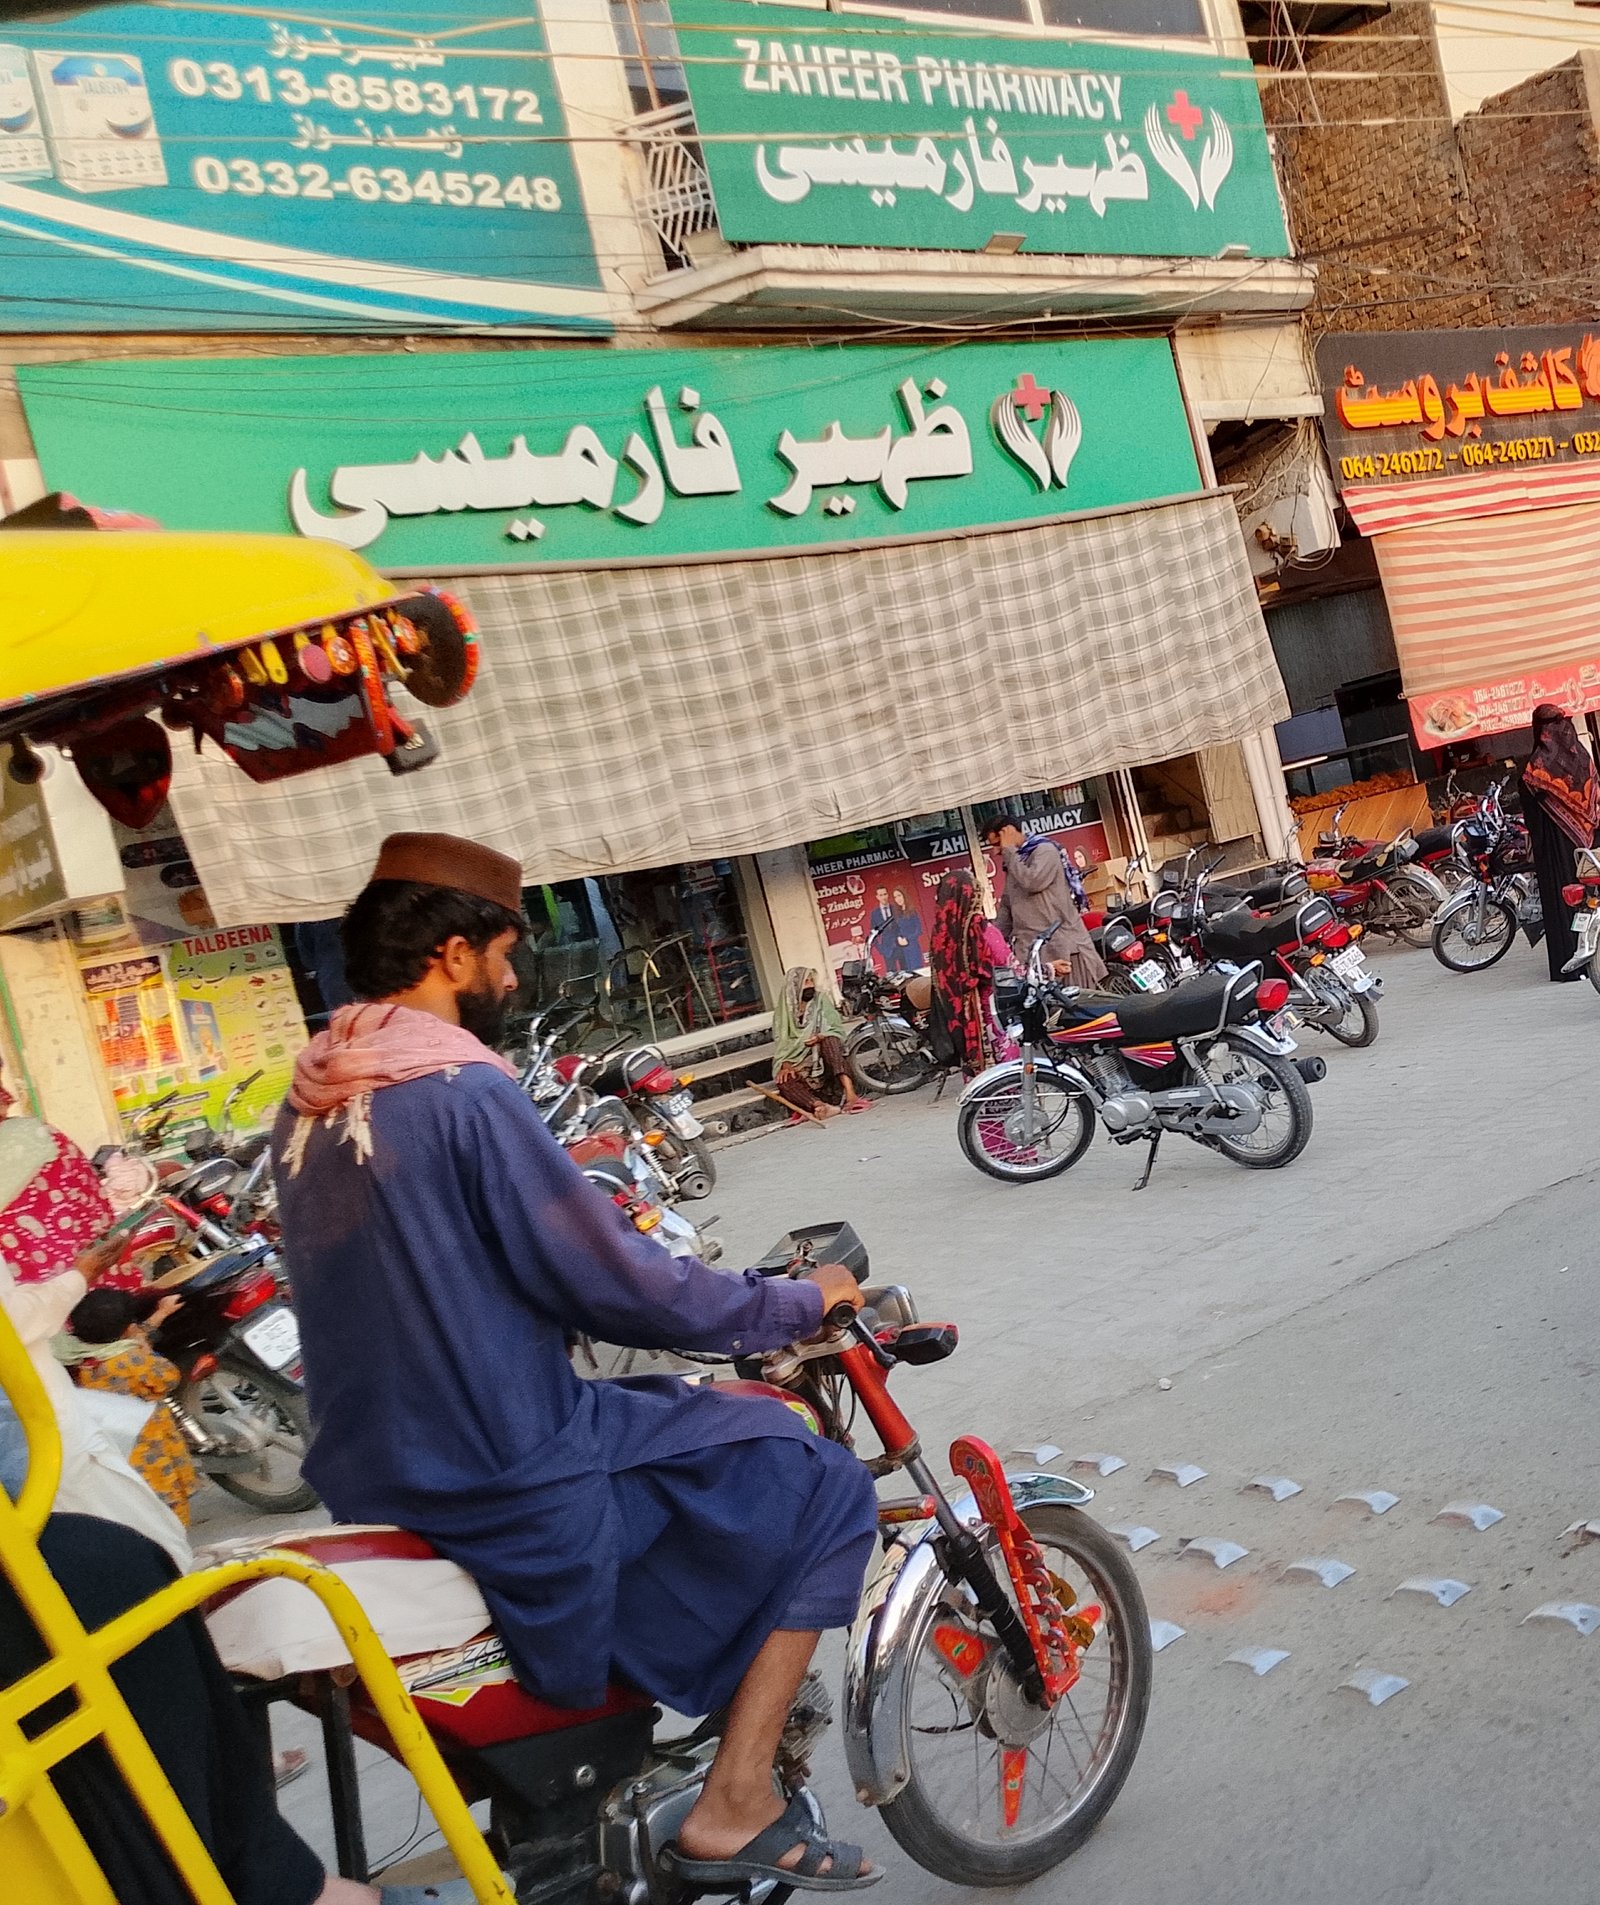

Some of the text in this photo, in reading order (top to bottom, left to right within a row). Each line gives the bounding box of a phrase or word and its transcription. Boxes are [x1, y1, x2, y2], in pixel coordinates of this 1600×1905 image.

[167, 58, 544, 126] 0313-8583172
[735, 37, 1123, 122] ZAHEER PHARMACY
[193, 156, 563, 212] 0332-6345248
[755, 115, 1149, 218] ظہیر فارمیسی
[1482, 347, 1584, 416] کاشف
[287, 376, 974, 549] ظہیر فارمیسی
[1341, 448, 1444, 480] 064-2461272
[1462, 436, 1555, 467] 064-2461271
[183, 925, 273, 957] TALBEENA
